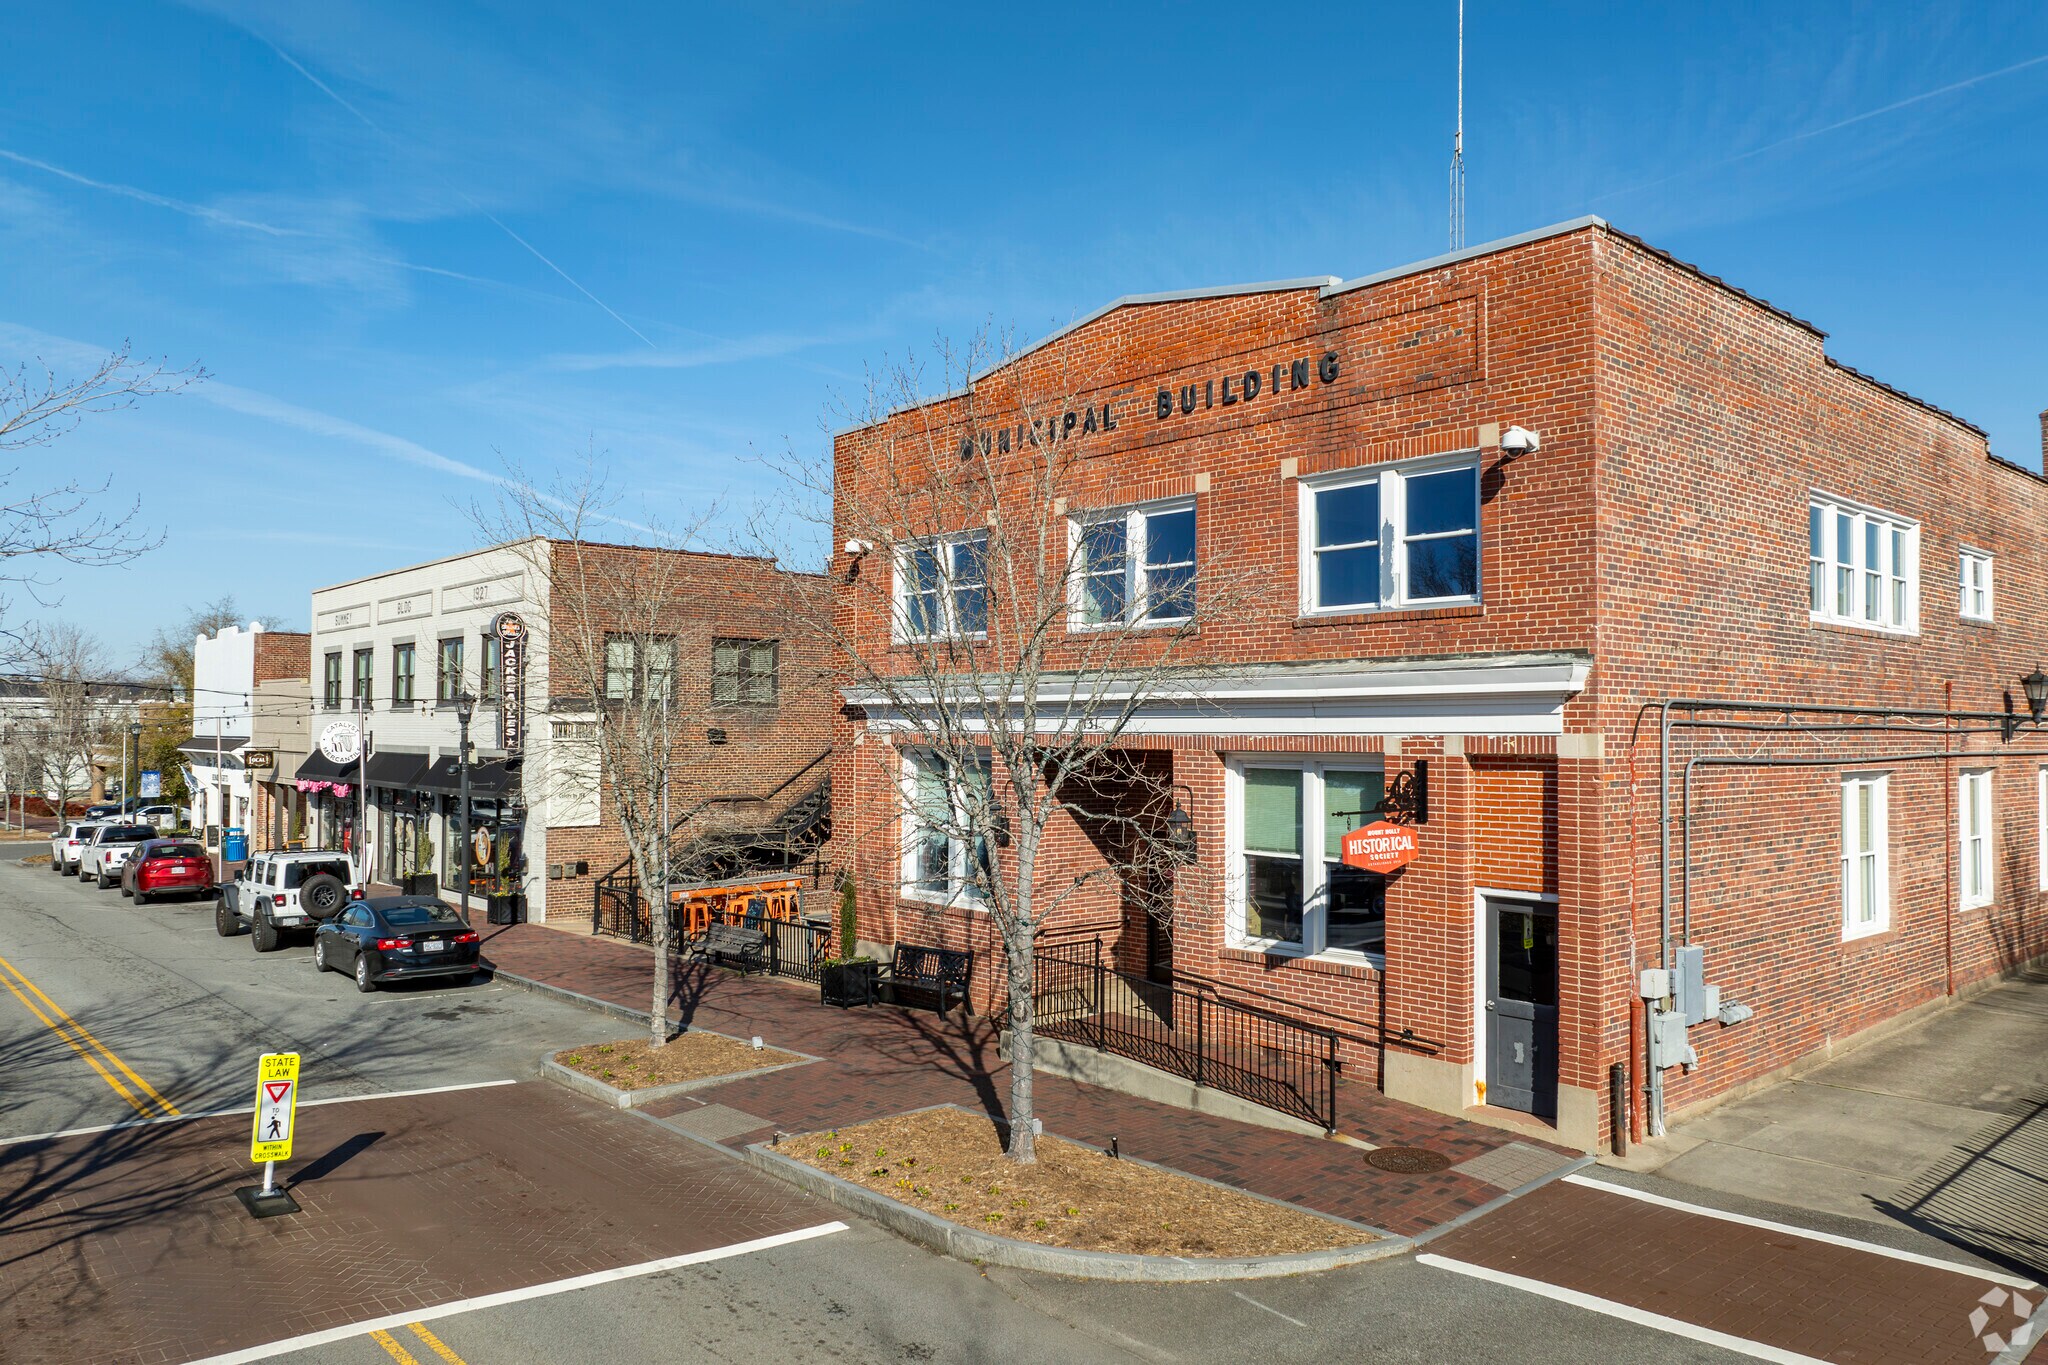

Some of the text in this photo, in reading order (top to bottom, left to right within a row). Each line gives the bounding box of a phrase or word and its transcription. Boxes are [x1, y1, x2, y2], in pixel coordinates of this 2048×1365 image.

[961, 351, 1341, 462] MUNICIPAL BUILDING
[473, 586, 488, 601] 1927
[397, 600, 412, 615] BLDG
[504, 640, 517, 737] JACKBEAGLES
[326, 722, 360, 734] CATALYST
[323, 746, 361, 763] MERCANTILE
[1349, 835, 1415, 856] HISTORICAL
[1370, 852, 1399, 861] SOCIETY
[265, 1057, 295, 1068] STATE
[268, 1068, 290, 1078] LAW
[254, 1150, 288, 1160] CROSSWALK
